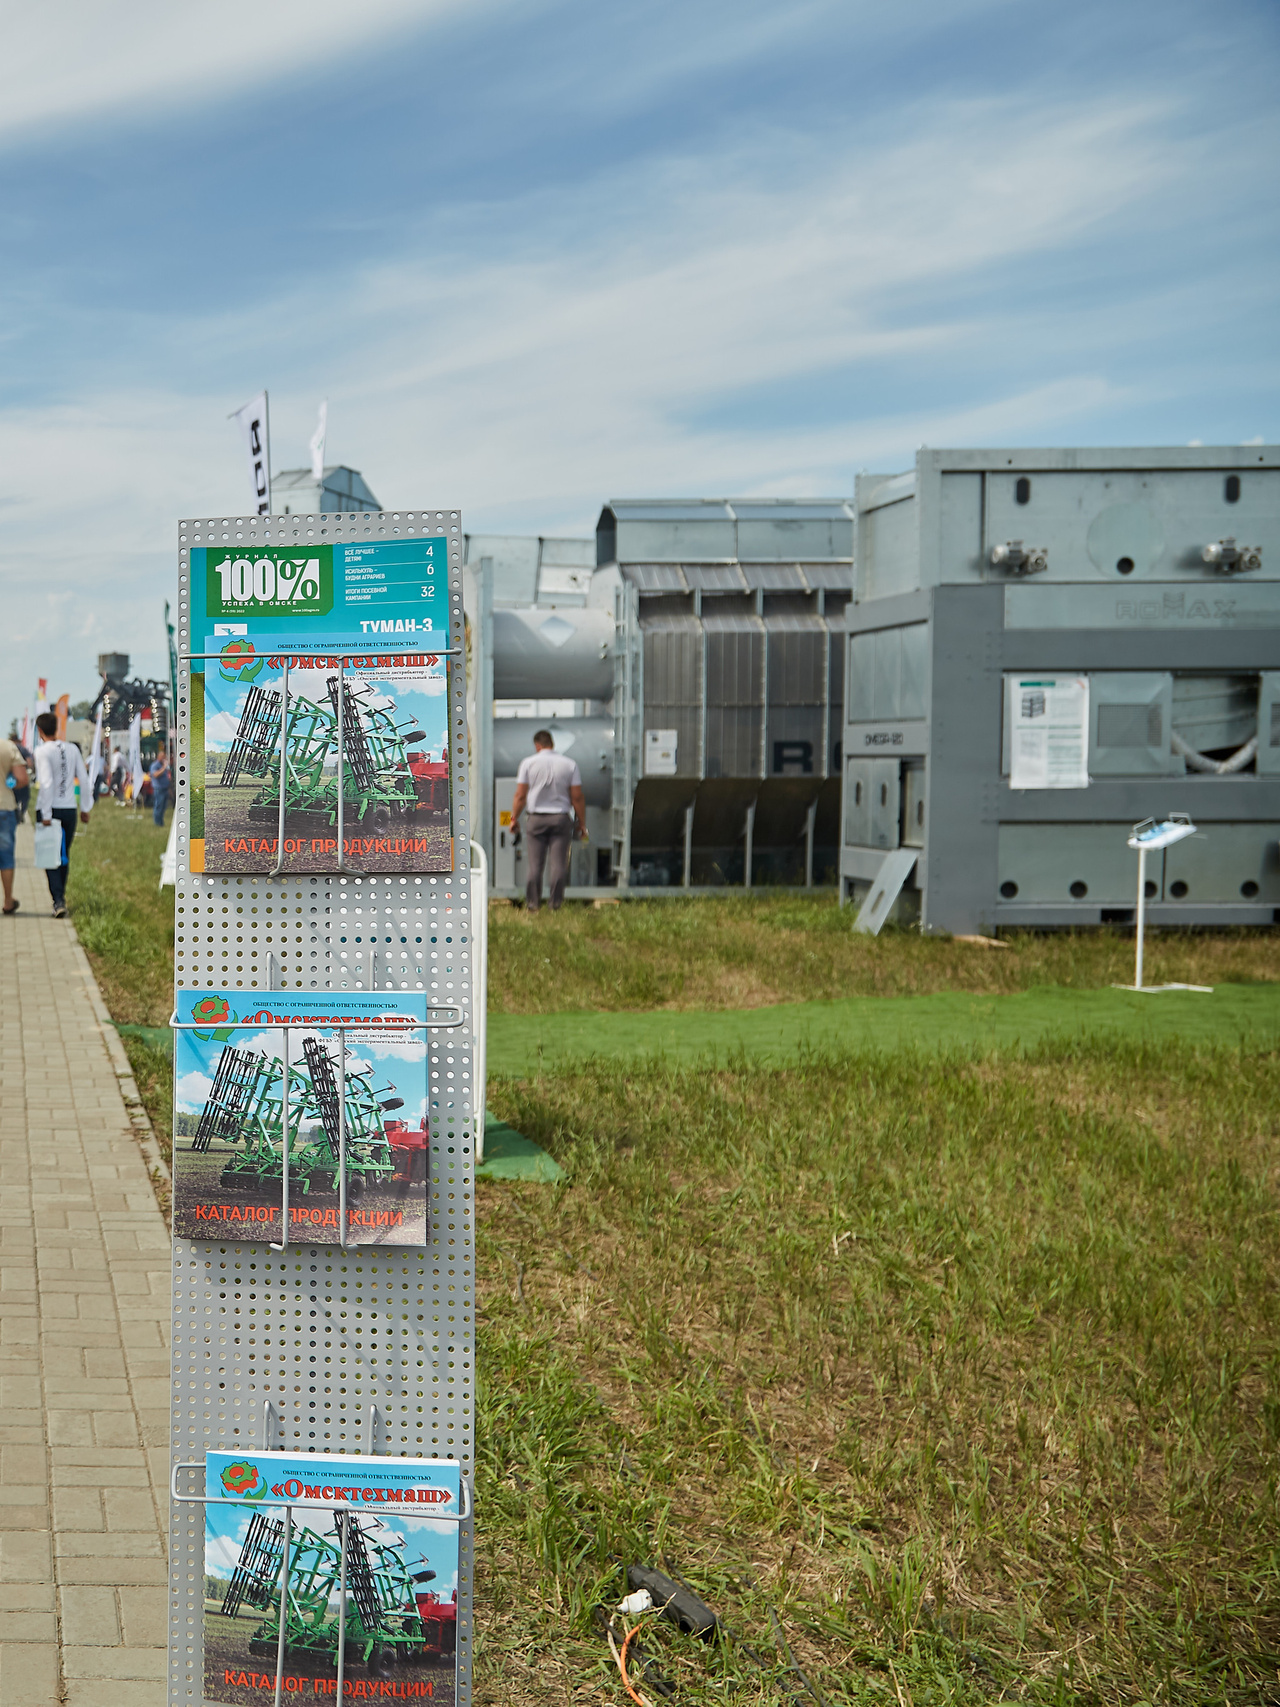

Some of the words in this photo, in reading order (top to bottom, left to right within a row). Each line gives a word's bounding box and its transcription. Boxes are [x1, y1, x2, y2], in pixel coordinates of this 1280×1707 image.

[426, 546, 433, 556] 4
[427, 564, 434, 575] 6
[215, 559, 320, 601] 100%
[421, 586, 435, 597] 32
[360, 618, 433, 633] ТУМАН-3
[225, 838, 306, 853] КАТАЛОГ
[312, 839, 427, 855] ПРОДУКЦИИ
[196, 1205, 280, 1222] КАТАЛОГ
[271, 1479, 452, 1503] «Омсктехмаш»
[225, 1670, 309, 1693] КАТАЛОГ
[314, 1678, 433, 1699] ПРОДУКЦИИ
